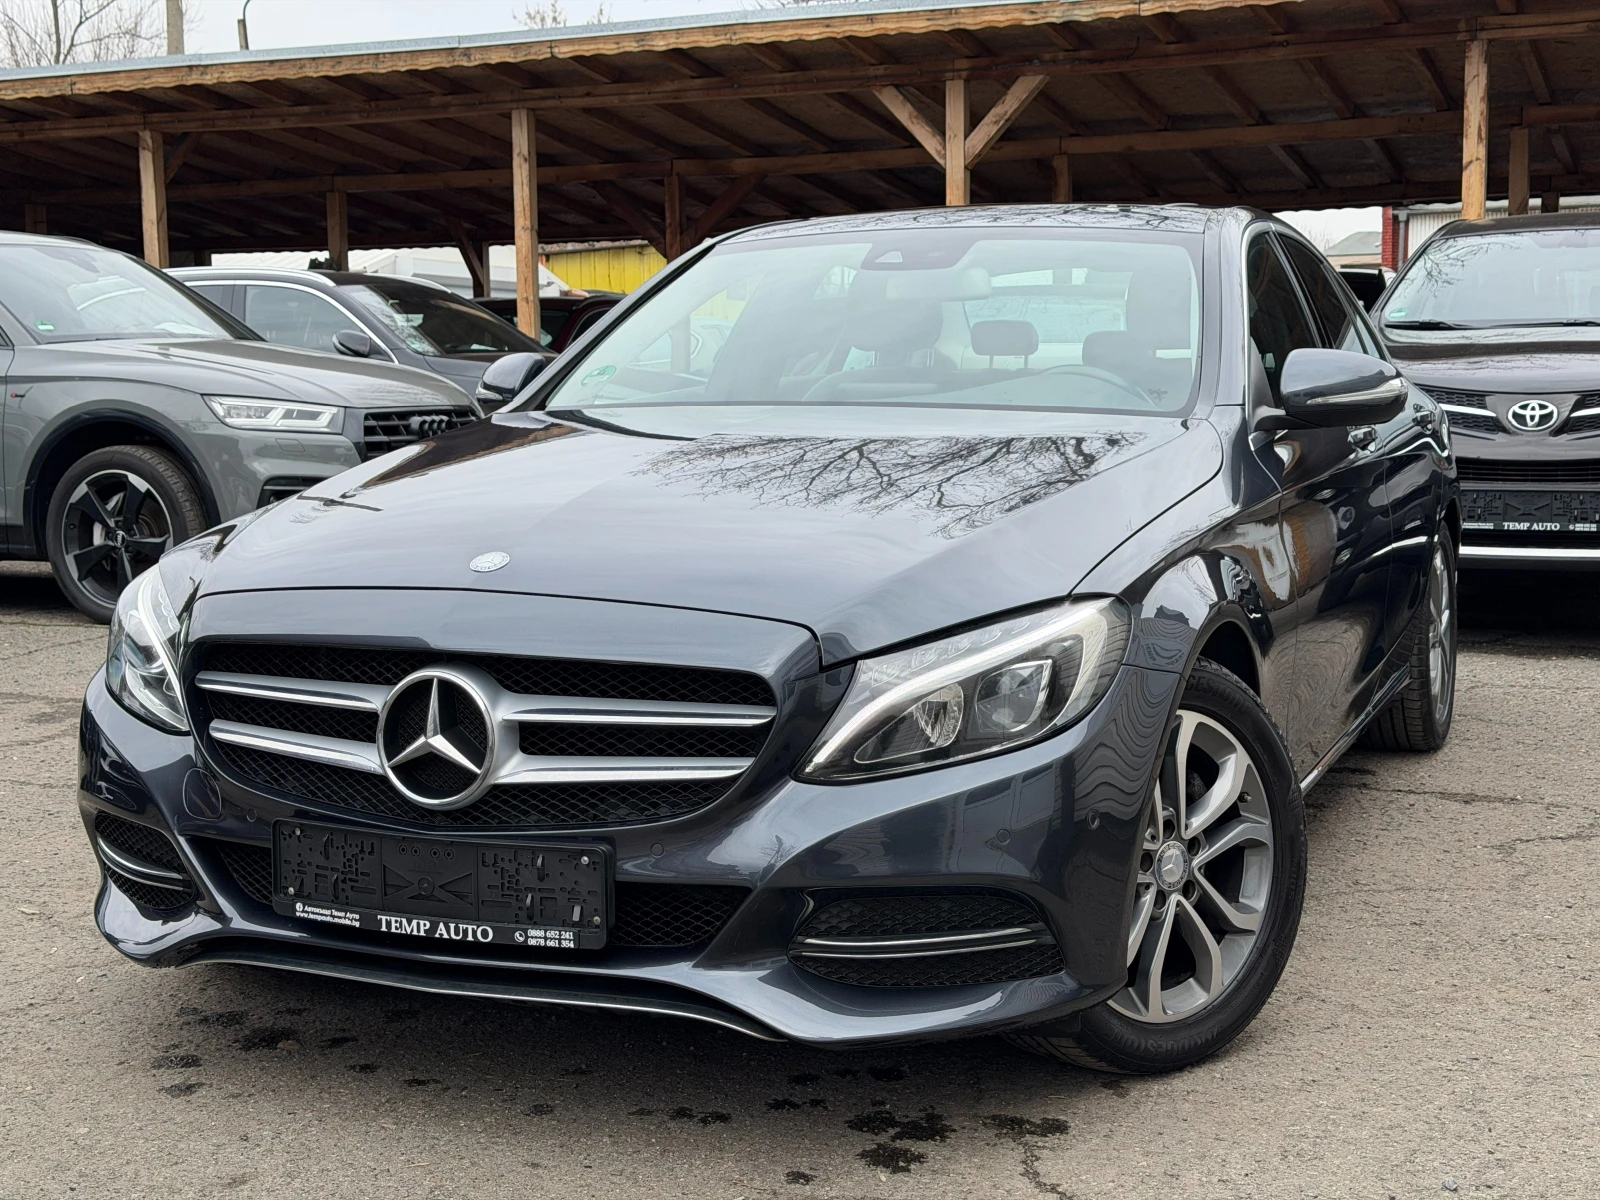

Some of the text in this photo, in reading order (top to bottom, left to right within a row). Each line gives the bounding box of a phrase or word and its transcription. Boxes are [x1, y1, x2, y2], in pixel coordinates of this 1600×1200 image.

[1503, 522, 1530, 530] TEMP
[1531, 522, 1560, 531] AUTO
[377, 915, 494, 943] TEMP AUTO
[527, 929, 575, 940] 0888 652 241
[527, 938, 575, 949] 0878 661 354
